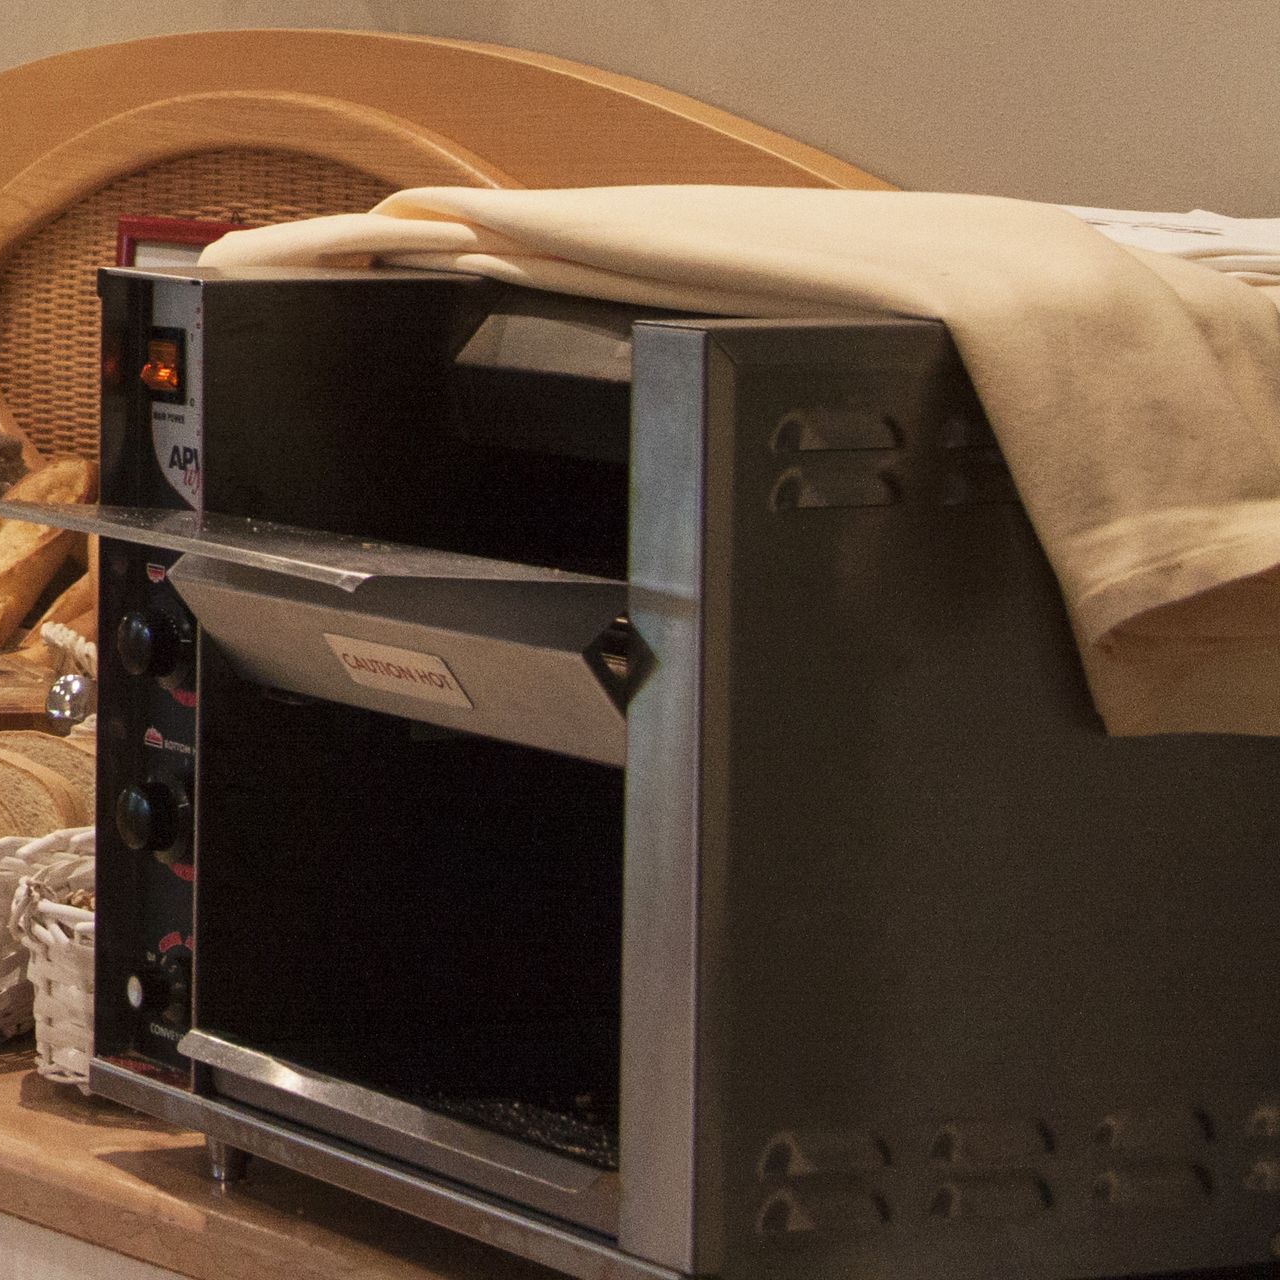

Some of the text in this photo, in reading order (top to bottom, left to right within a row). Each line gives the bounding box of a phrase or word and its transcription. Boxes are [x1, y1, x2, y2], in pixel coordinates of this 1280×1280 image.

[342, 652, 454, 691] CAUTION HOT
[164, 739, 191, 754] BOTTOM
